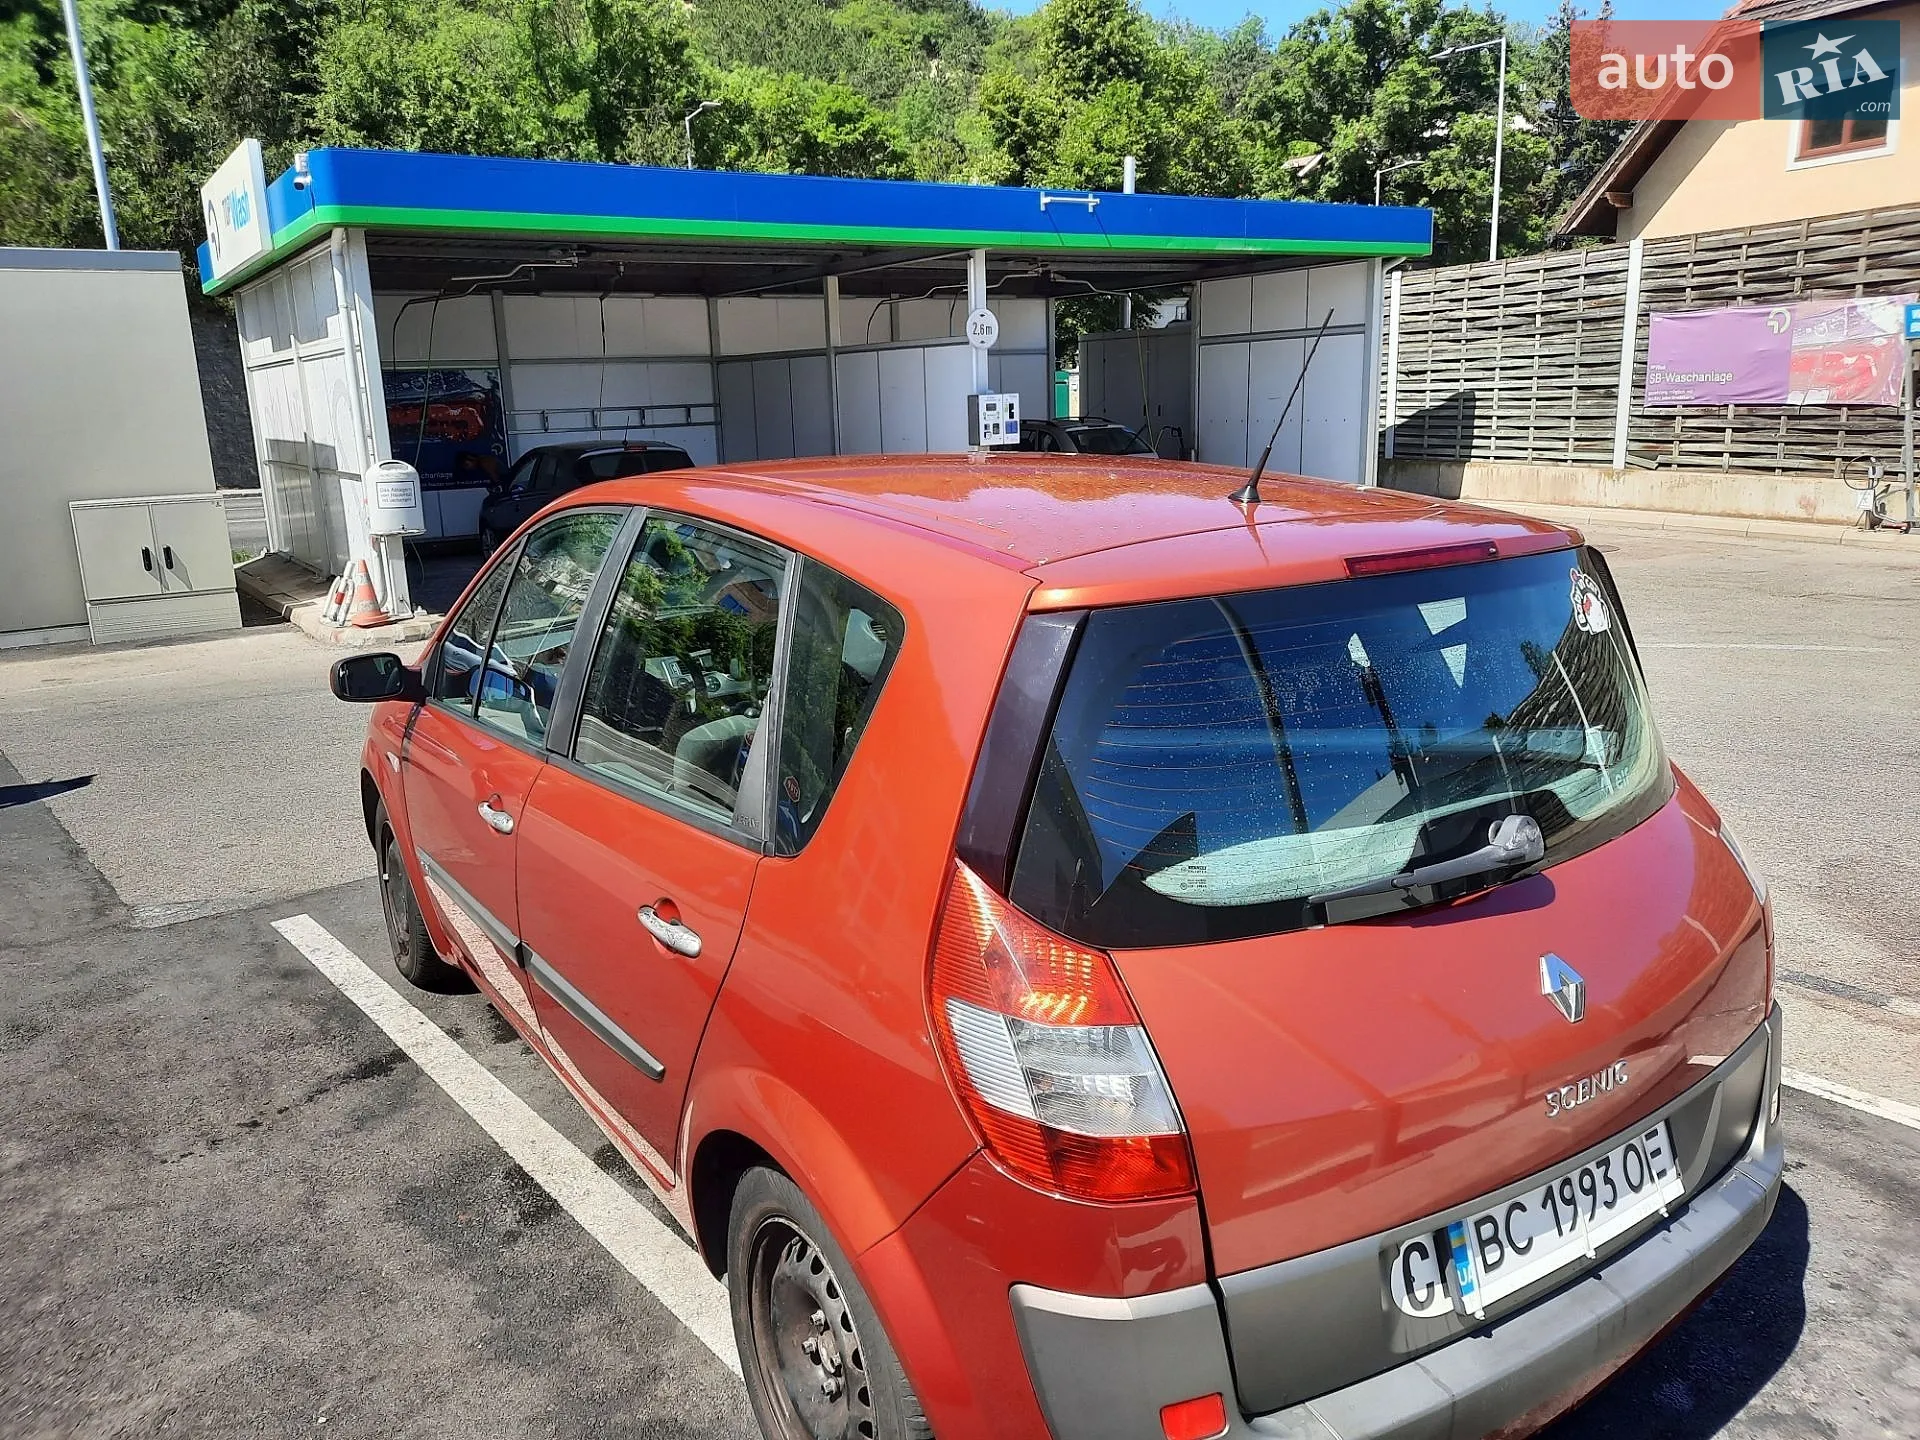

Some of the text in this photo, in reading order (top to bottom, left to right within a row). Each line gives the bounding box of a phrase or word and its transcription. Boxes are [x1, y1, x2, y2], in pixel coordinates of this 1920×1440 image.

[1649, 369, 1734, 385] SB-Waschanlage
[1544, 1059, 1629, 1119] SCENIC
[1474, 1128, 1668, 1274] BC 1993 OE
